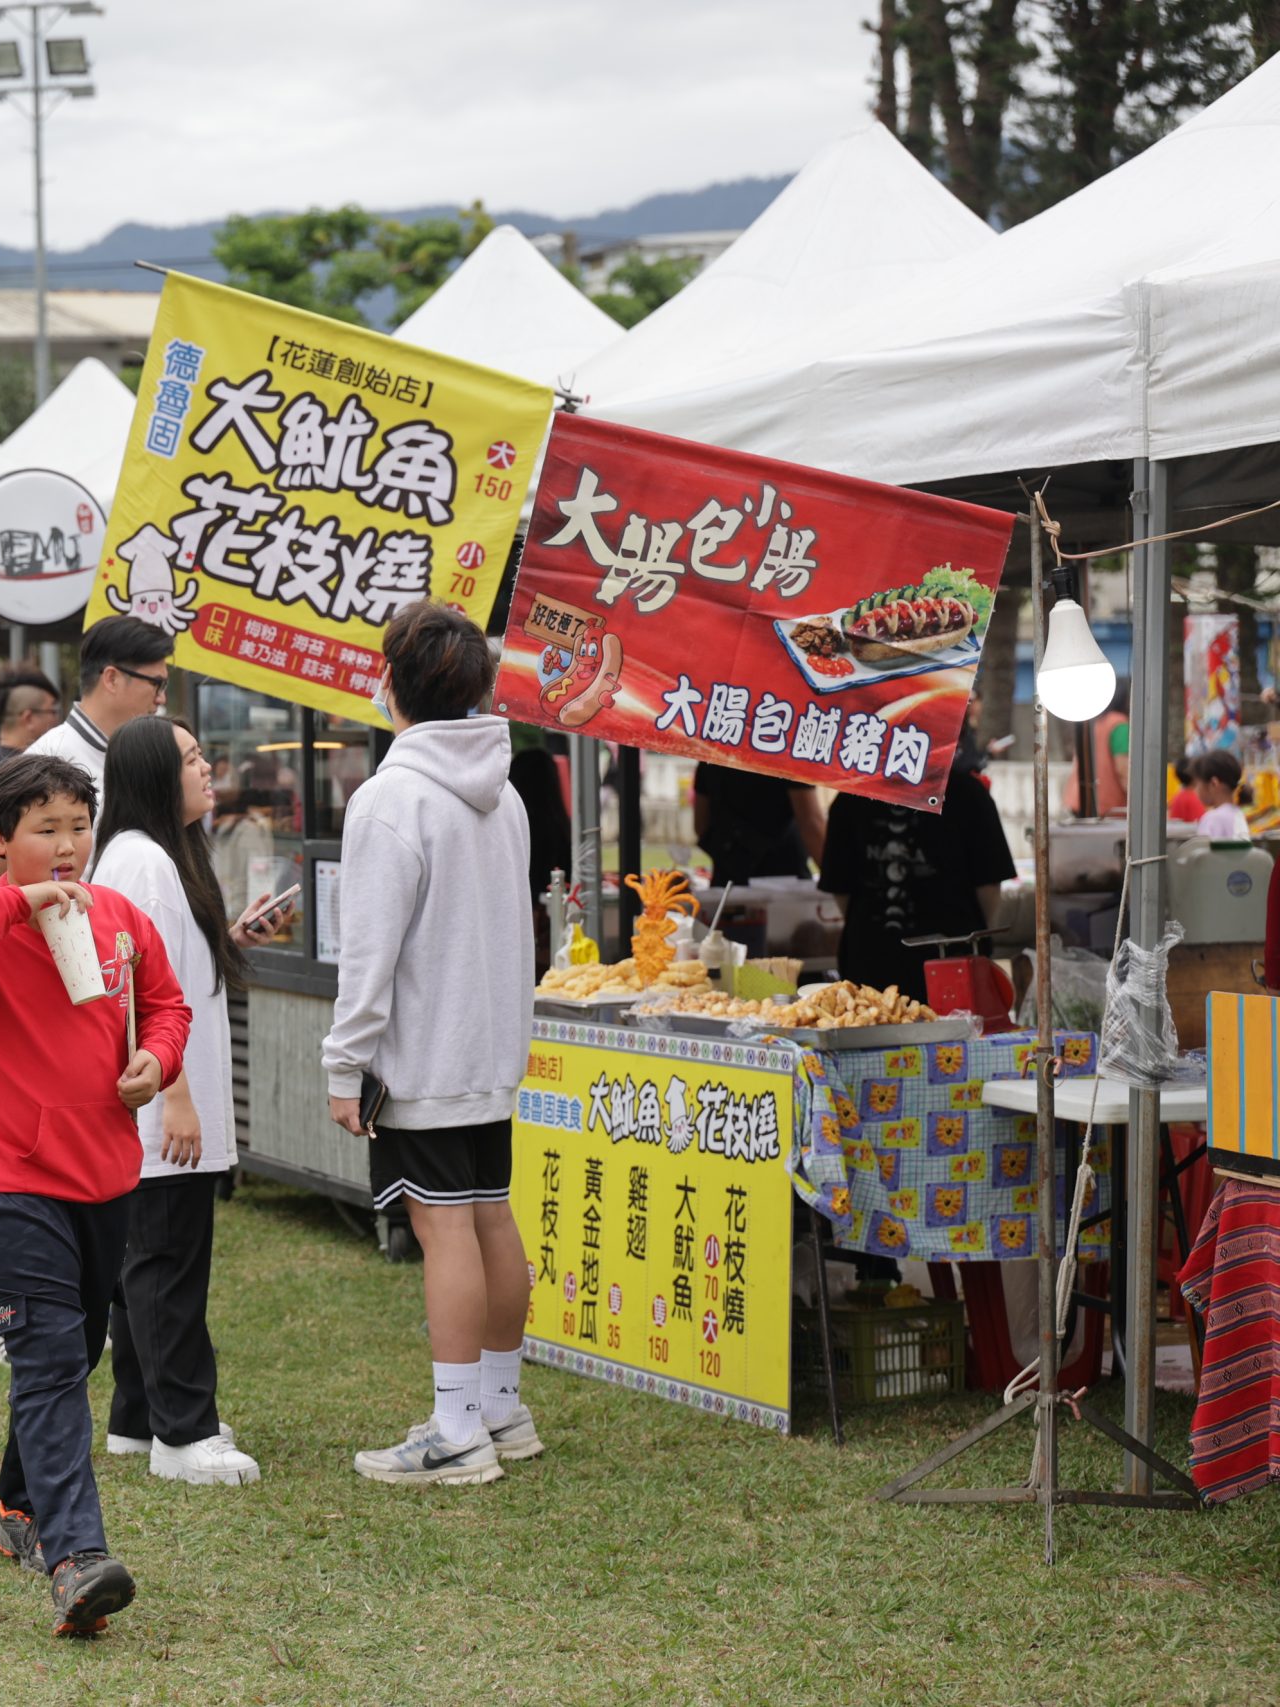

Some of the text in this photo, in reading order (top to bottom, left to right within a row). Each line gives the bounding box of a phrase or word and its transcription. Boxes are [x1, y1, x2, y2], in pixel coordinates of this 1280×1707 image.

[267, 335, 434, 408] 【花蓮創始店】
[146, 338, 204, 458] 德魯固
[189, 370, 457, 526] 大魷魚
[488, 441, 516, 470] 大
[474, 473, 513, 502] 150
[170, 472, 433, 626] 花枝燒
[457, 542, 483, 568] 小
[542, 467, 817, 612] 大腸包小腸
[449, 572, 477, 598] 70
[204, 606, 230, 647] 口味
[238, 639, 289, 669] 美乃滋
[656, 674, 931, 785] 大腸包鹹豬肉
[518, 1090, 582, 1131] 德魯固美食
[586, 1071, 780, 1162] 大魷魚 花枝燒
[538, 1148, 561, 1286] 花枝丸
[626, 1165, 649, 1261] 雞翅
[578, 1156, 604, 1345] 黃金地瓜
[671, 1174, 697, 1323] 大魷魚
[705, 1235, 720, 1267] 小
[722, 1184, 748, 1336] 花枝燒
[704, 1274, 719, 1302] 70
[563, 1311, 576, 1336] 60
[607, 1323, 620, 1350] 35
[703, 1310, 718, 1344] 大
[648, 1335, 669, 1364] 150
[698, 1349, 721, 1378] 120
